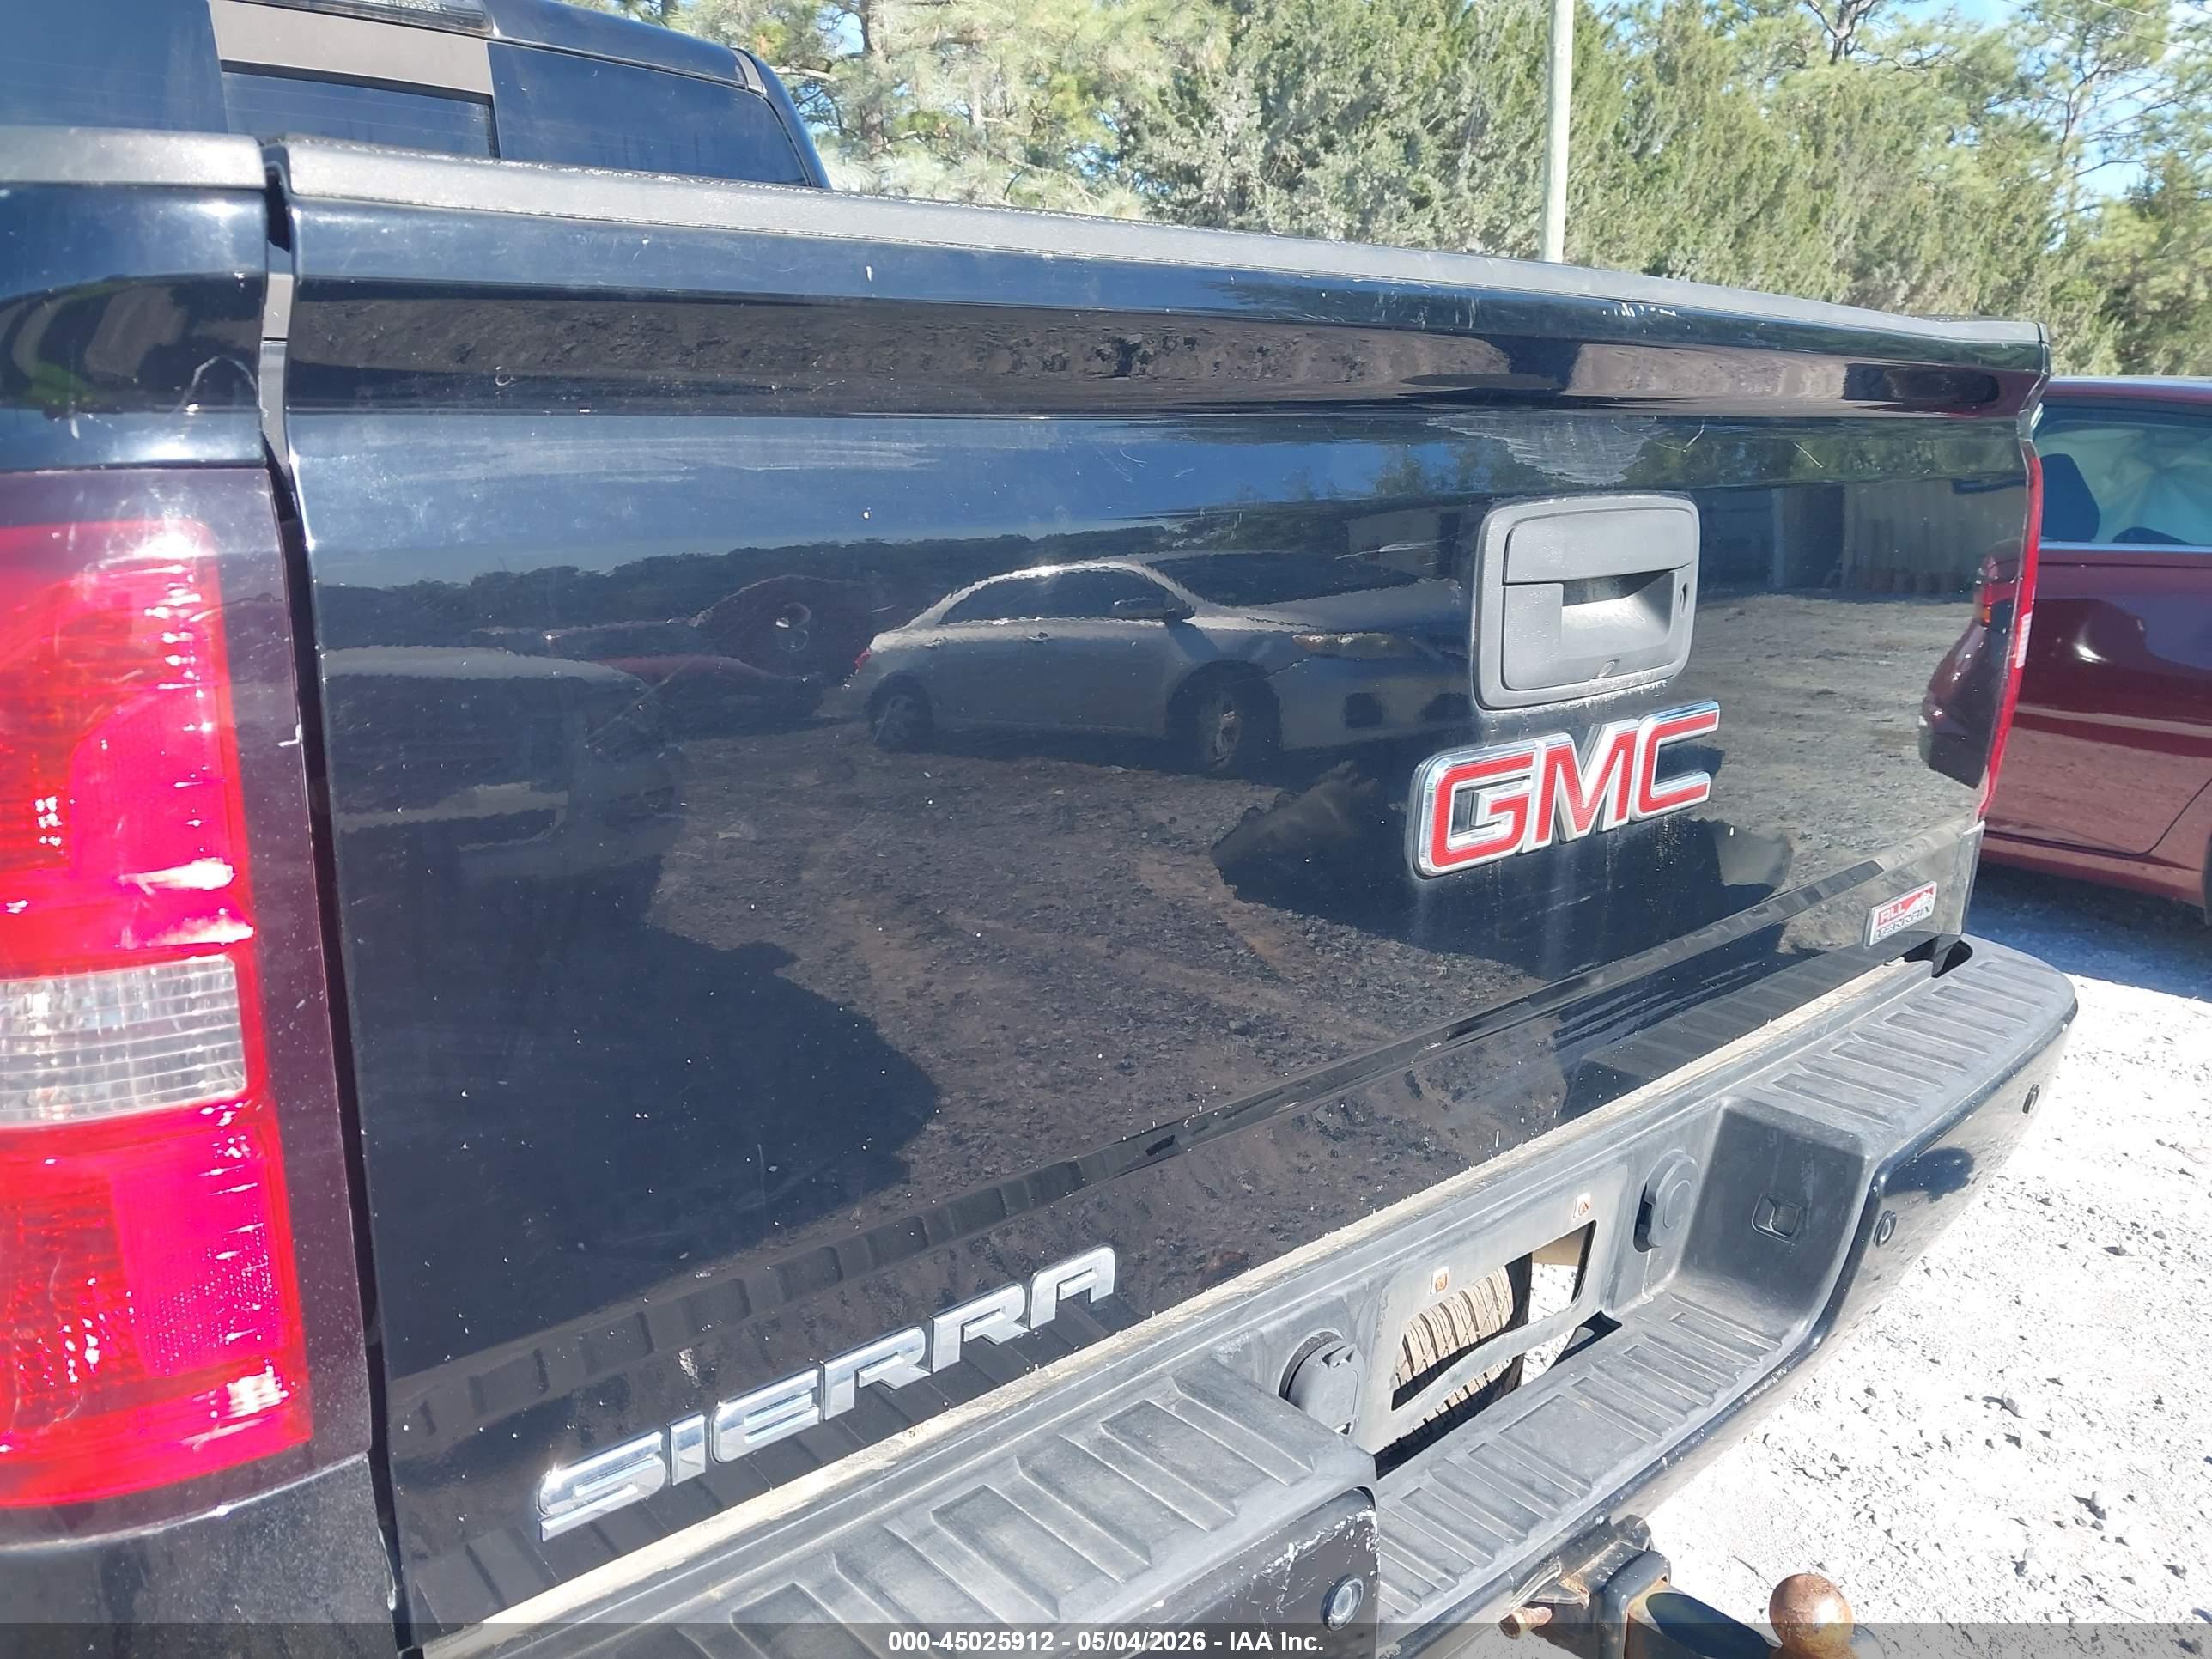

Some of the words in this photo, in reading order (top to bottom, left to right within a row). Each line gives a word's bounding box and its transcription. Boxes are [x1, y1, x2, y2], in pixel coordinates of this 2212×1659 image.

[1413, 700, 1720, 878] GMC
[1878, 903, 1906, 924] ALL
[538, 1246, 1116, 1542] SIERRA
